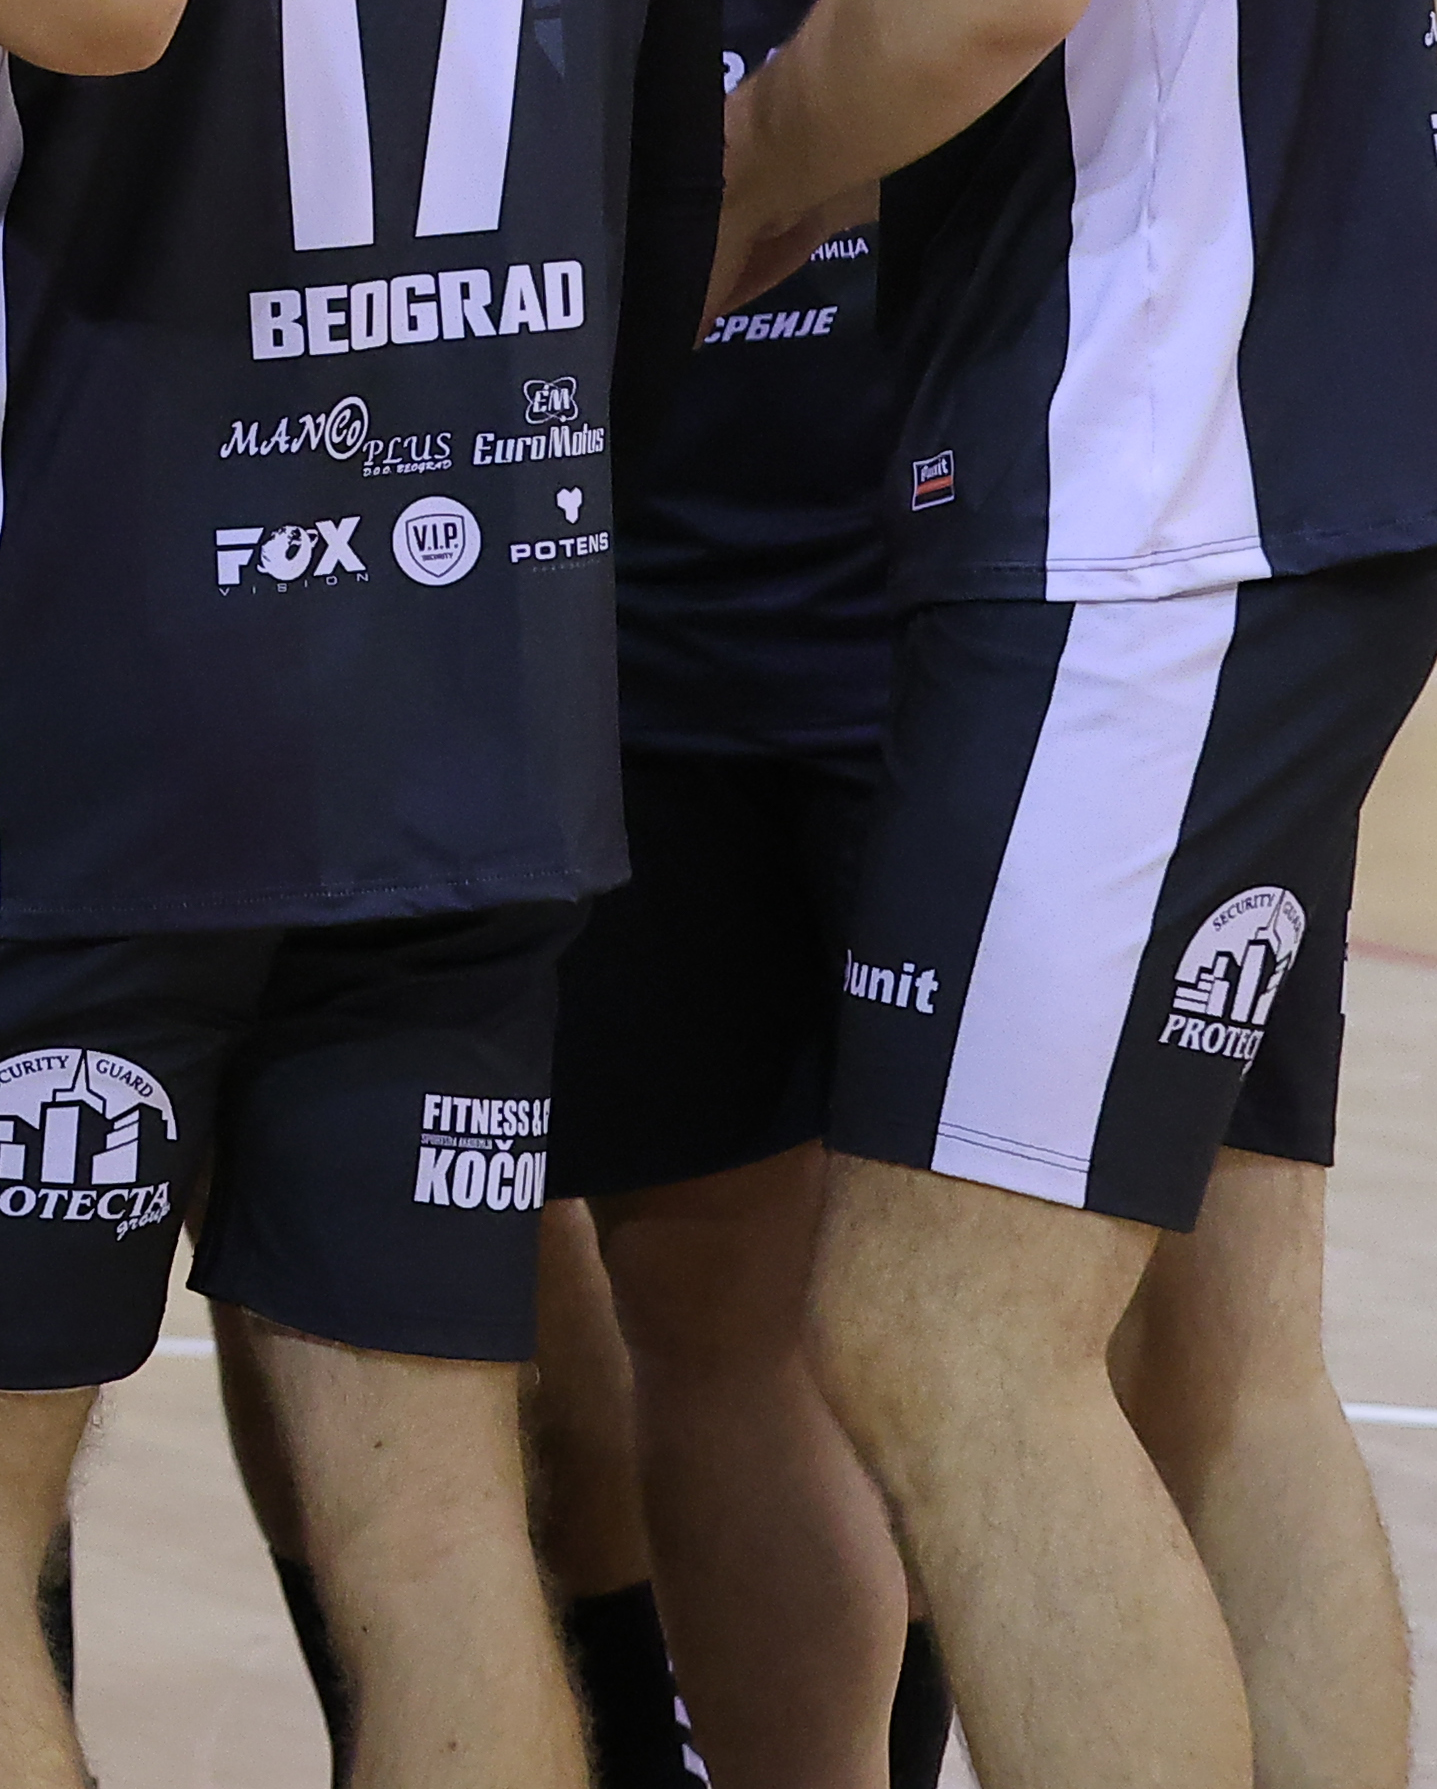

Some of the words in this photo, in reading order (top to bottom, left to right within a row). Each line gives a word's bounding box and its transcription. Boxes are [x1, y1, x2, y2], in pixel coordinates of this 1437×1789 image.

[249, 260, 584, 361] BEOGRAD
[362, 432, 452, 466] PLUS
[216, 516, 366, 585] FOX
[413, 522, 459, 551] V.I.P.
[510, 532, 609, 563] POTENS
[219, 572, 369, 596] VISION
[1213, 893, 1275, 931] SECURITY
[851, 962, 939, 1014] unit
[95, 1058, 154, 1098] GUARD
[423, 1093, 530, 1137] FITNESS
